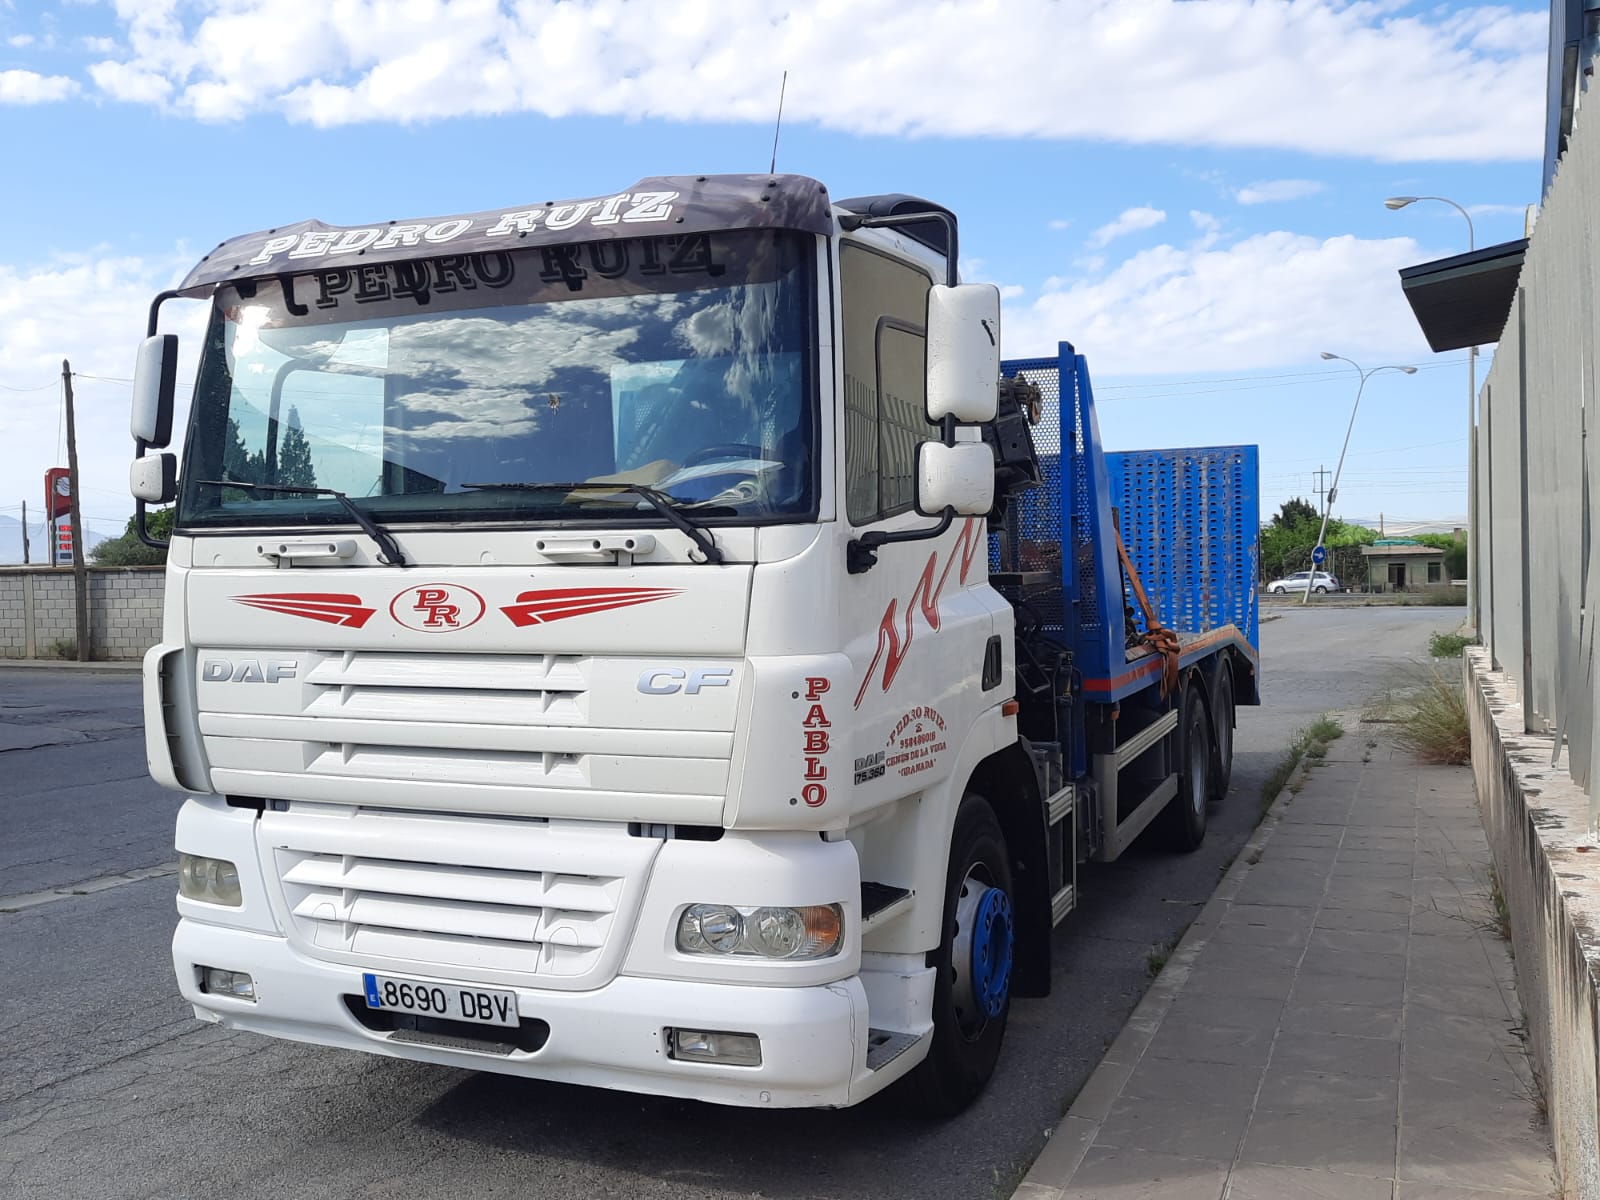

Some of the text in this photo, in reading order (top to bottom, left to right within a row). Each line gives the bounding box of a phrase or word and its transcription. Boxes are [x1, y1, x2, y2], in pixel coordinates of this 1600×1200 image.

[249, 191, 680, 265] PEDRO RUIZ
[312, 232, 713, 309] PEDRO RUIZ
[202, 659, 298, 684] DAF
[636, 667, 734, 695] CF
[802, 677, 832, 807] PABLO
[855, 751, 885, 771] DAF
[384, 981, 508, 1023] 8690 DBV
